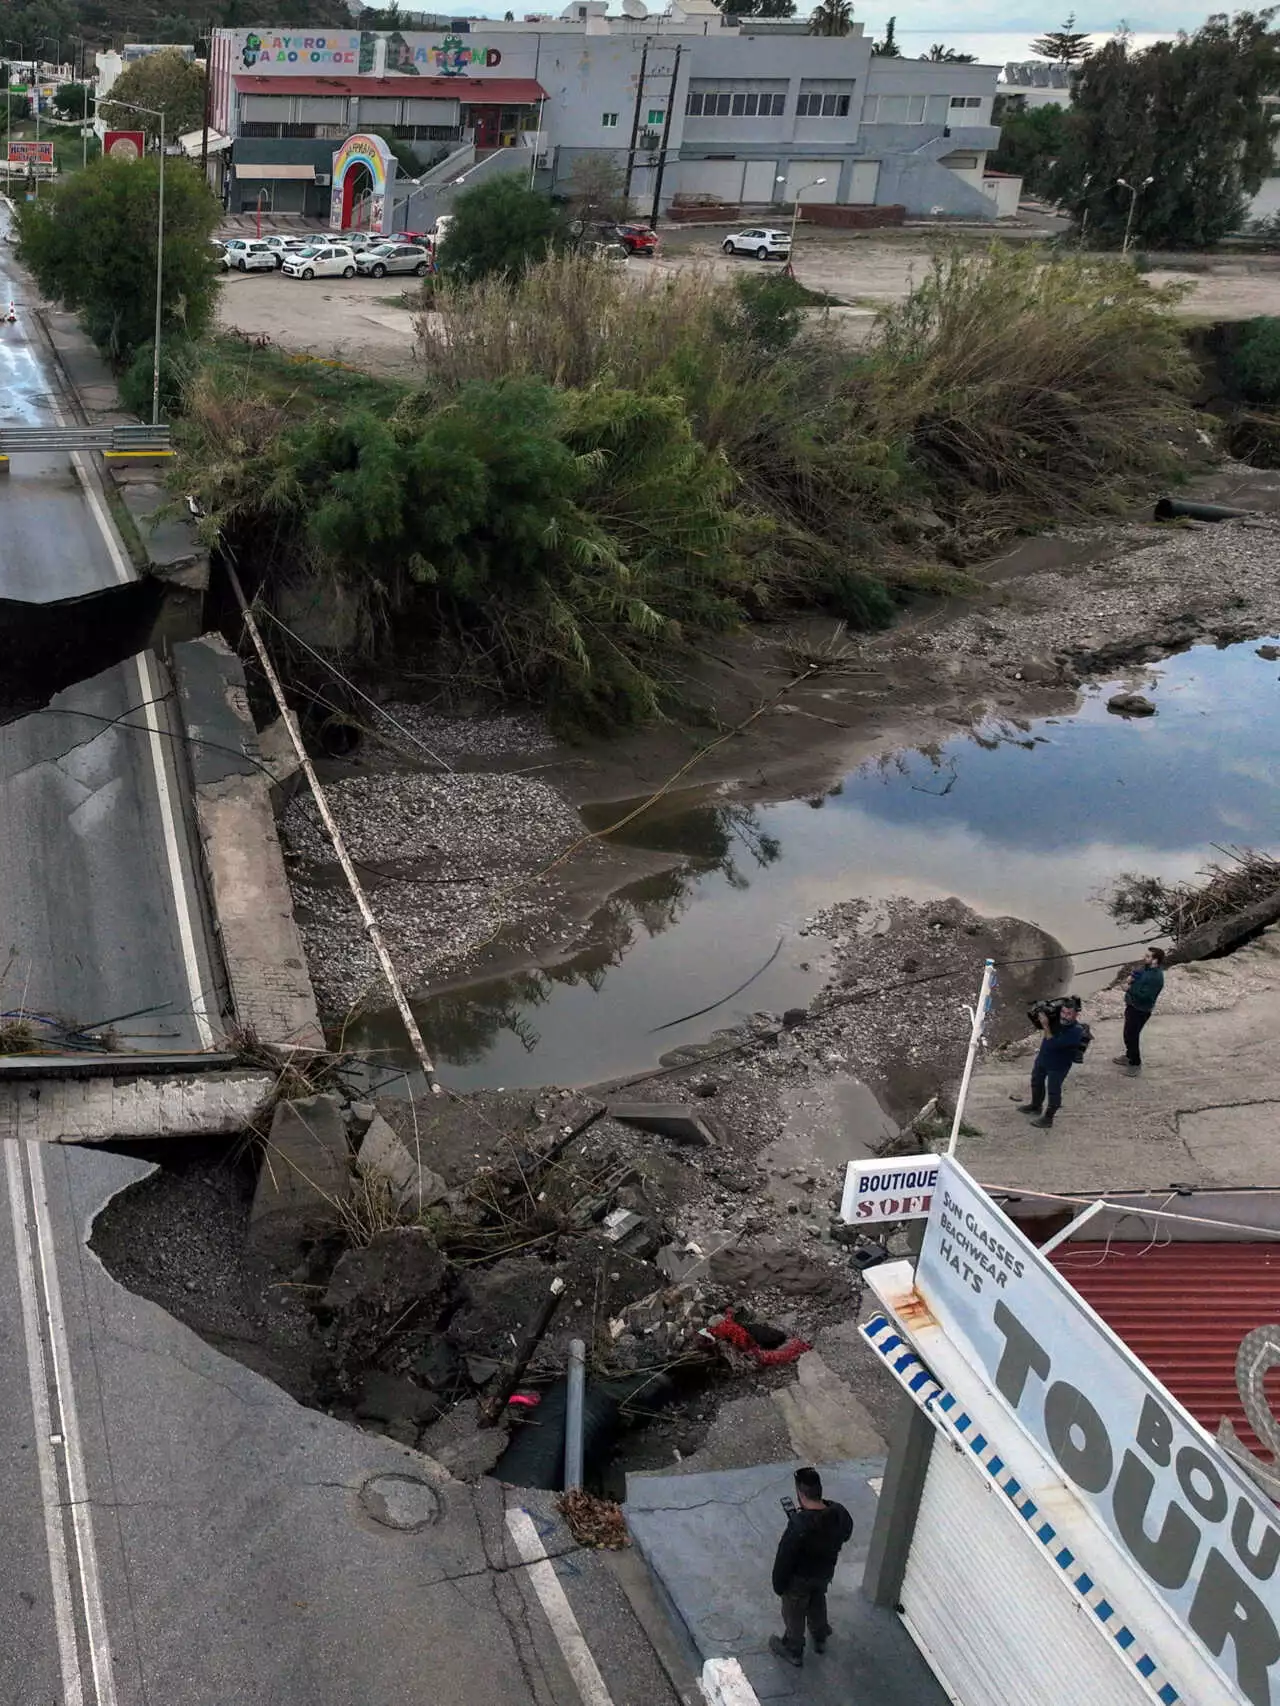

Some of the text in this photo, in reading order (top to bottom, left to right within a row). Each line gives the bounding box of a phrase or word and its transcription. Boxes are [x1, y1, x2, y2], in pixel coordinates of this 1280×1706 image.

[859, 1170, 939, 1193] BOUTIQUE
[939, 1238, 984, 1294] HATS
[940, 1212, 1008, 1289] BEACHWEAR
[943, 1191, 1025, 1279] SUN GLASSES
[993, 1299, 1280, 1706] TOUR
